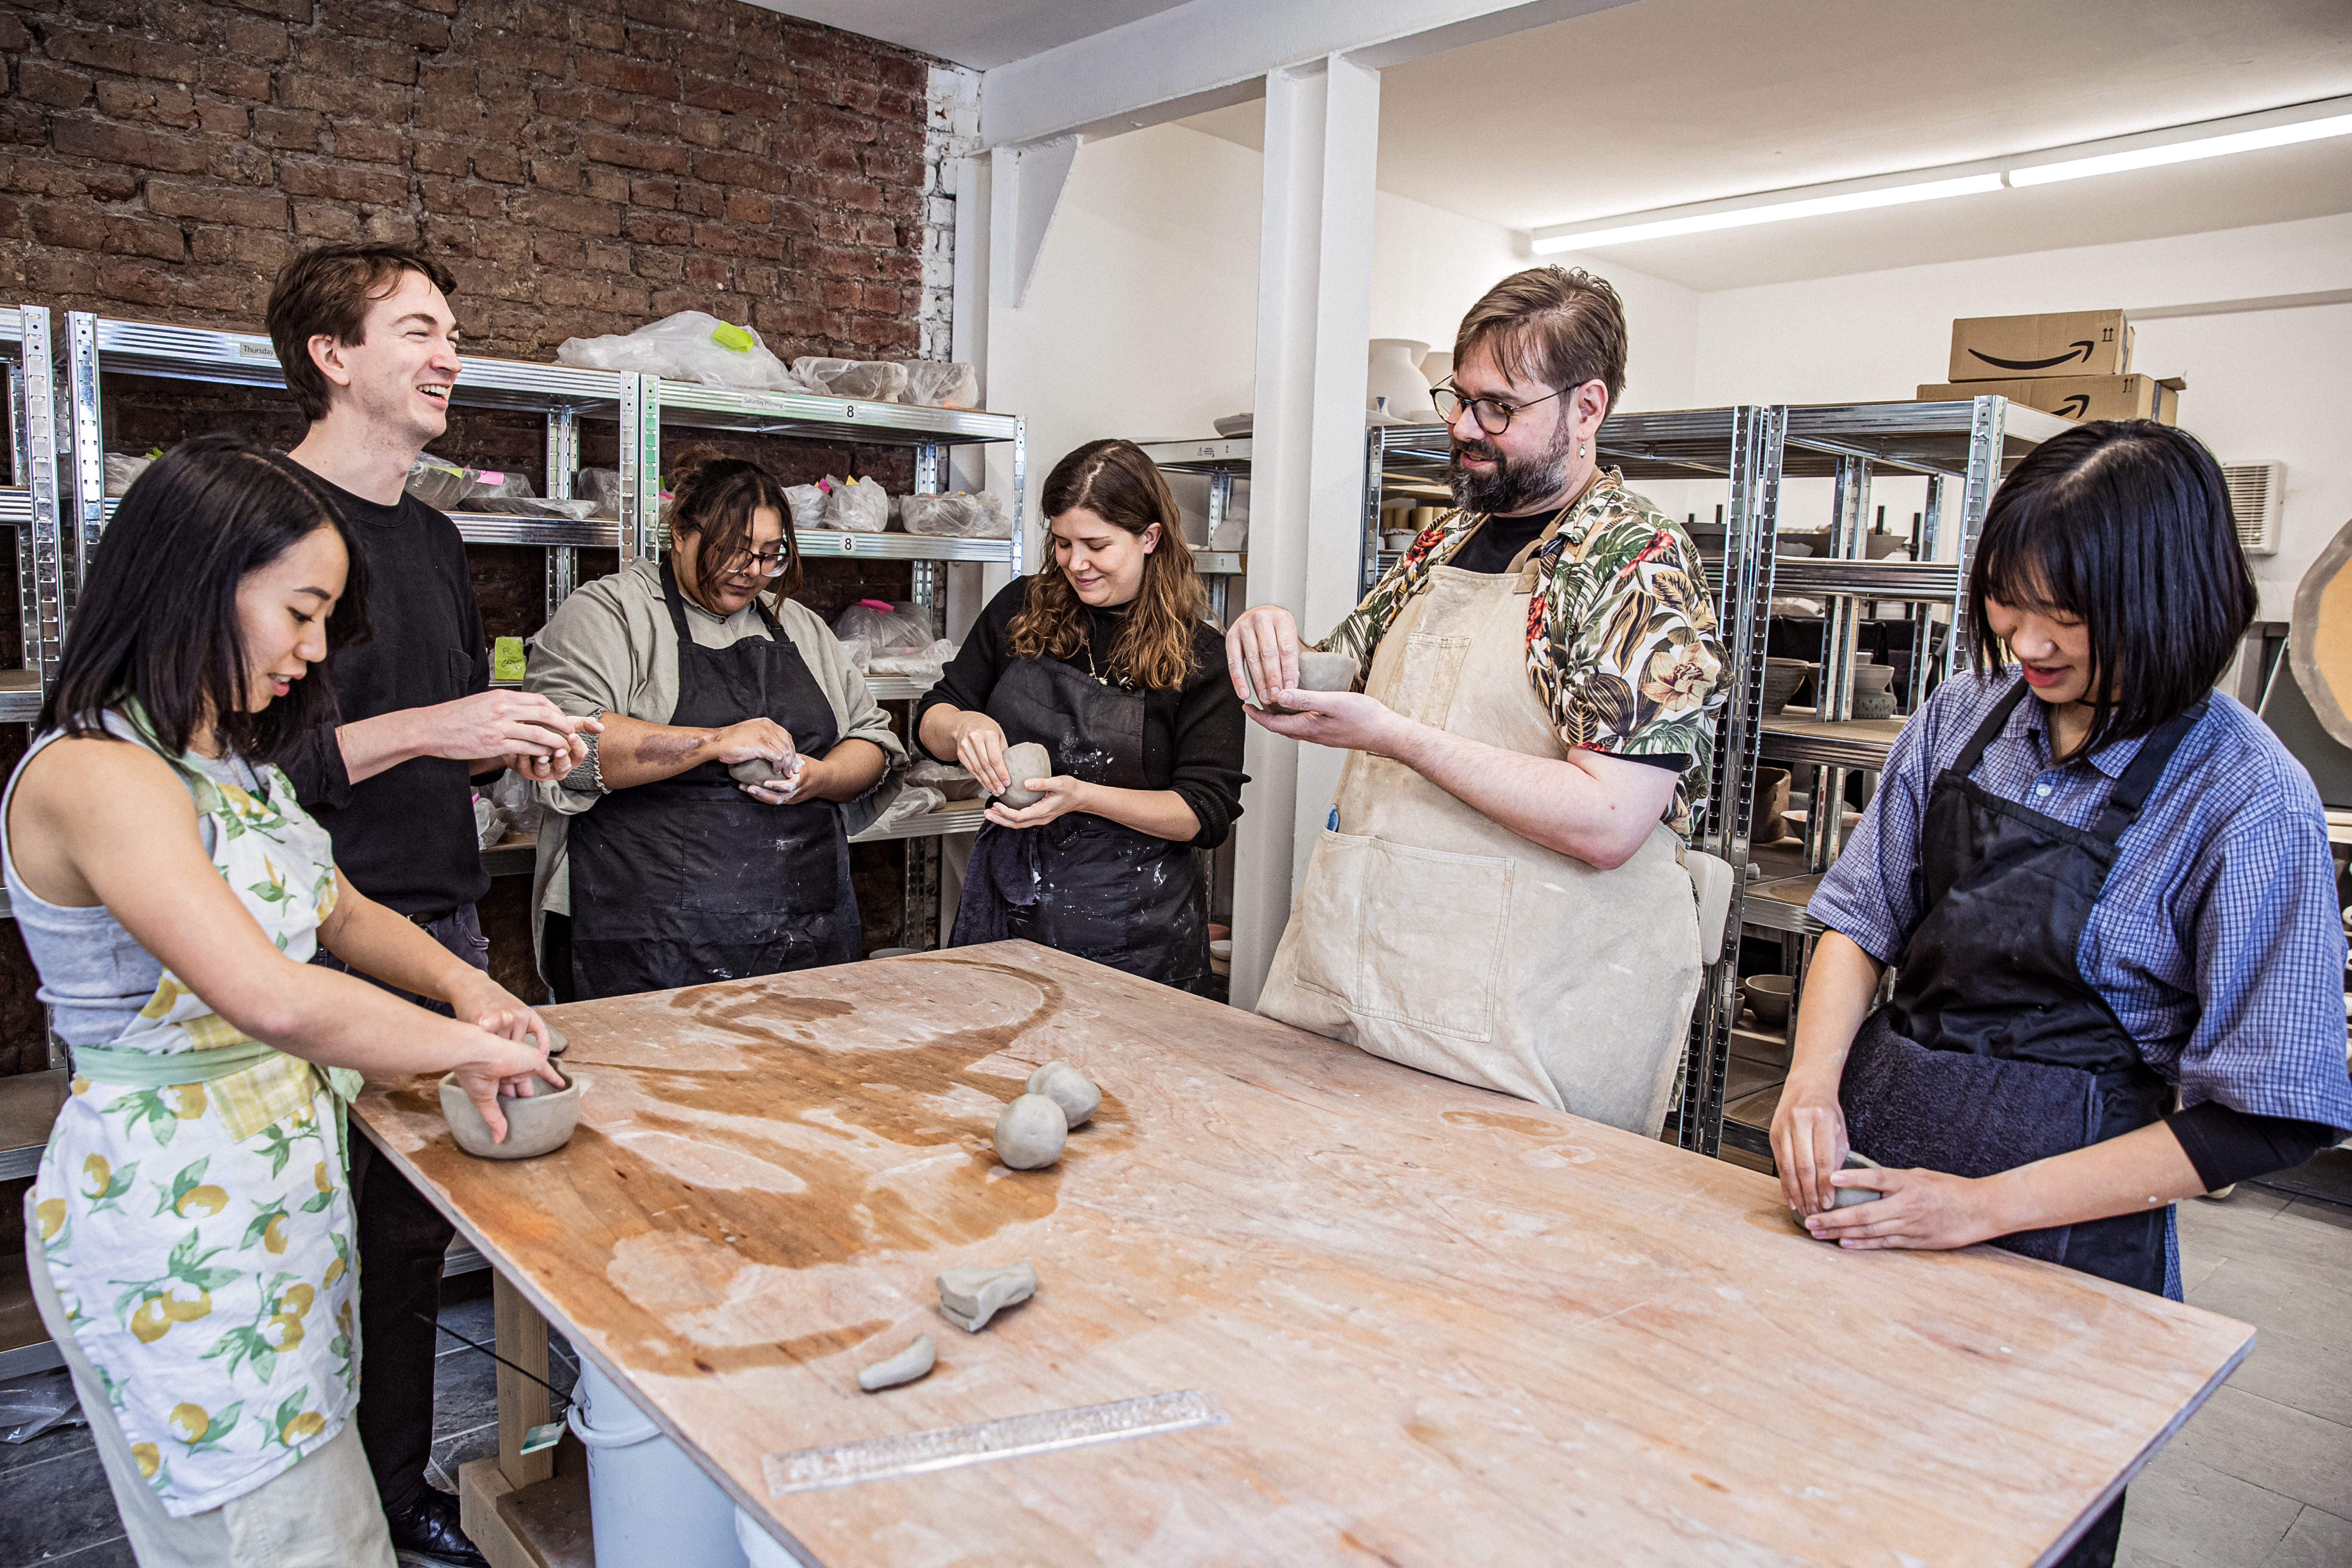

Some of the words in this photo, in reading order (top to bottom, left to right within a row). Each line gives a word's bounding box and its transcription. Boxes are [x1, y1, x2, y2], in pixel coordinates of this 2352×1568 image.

[243, 345, 274, 356] Thursday
[744, 397, 764, 407] Saturday
[765, 401, 783, 409] Morning
[847, 405, 854, 418] 8
[845, 538, 852, 550] 8
